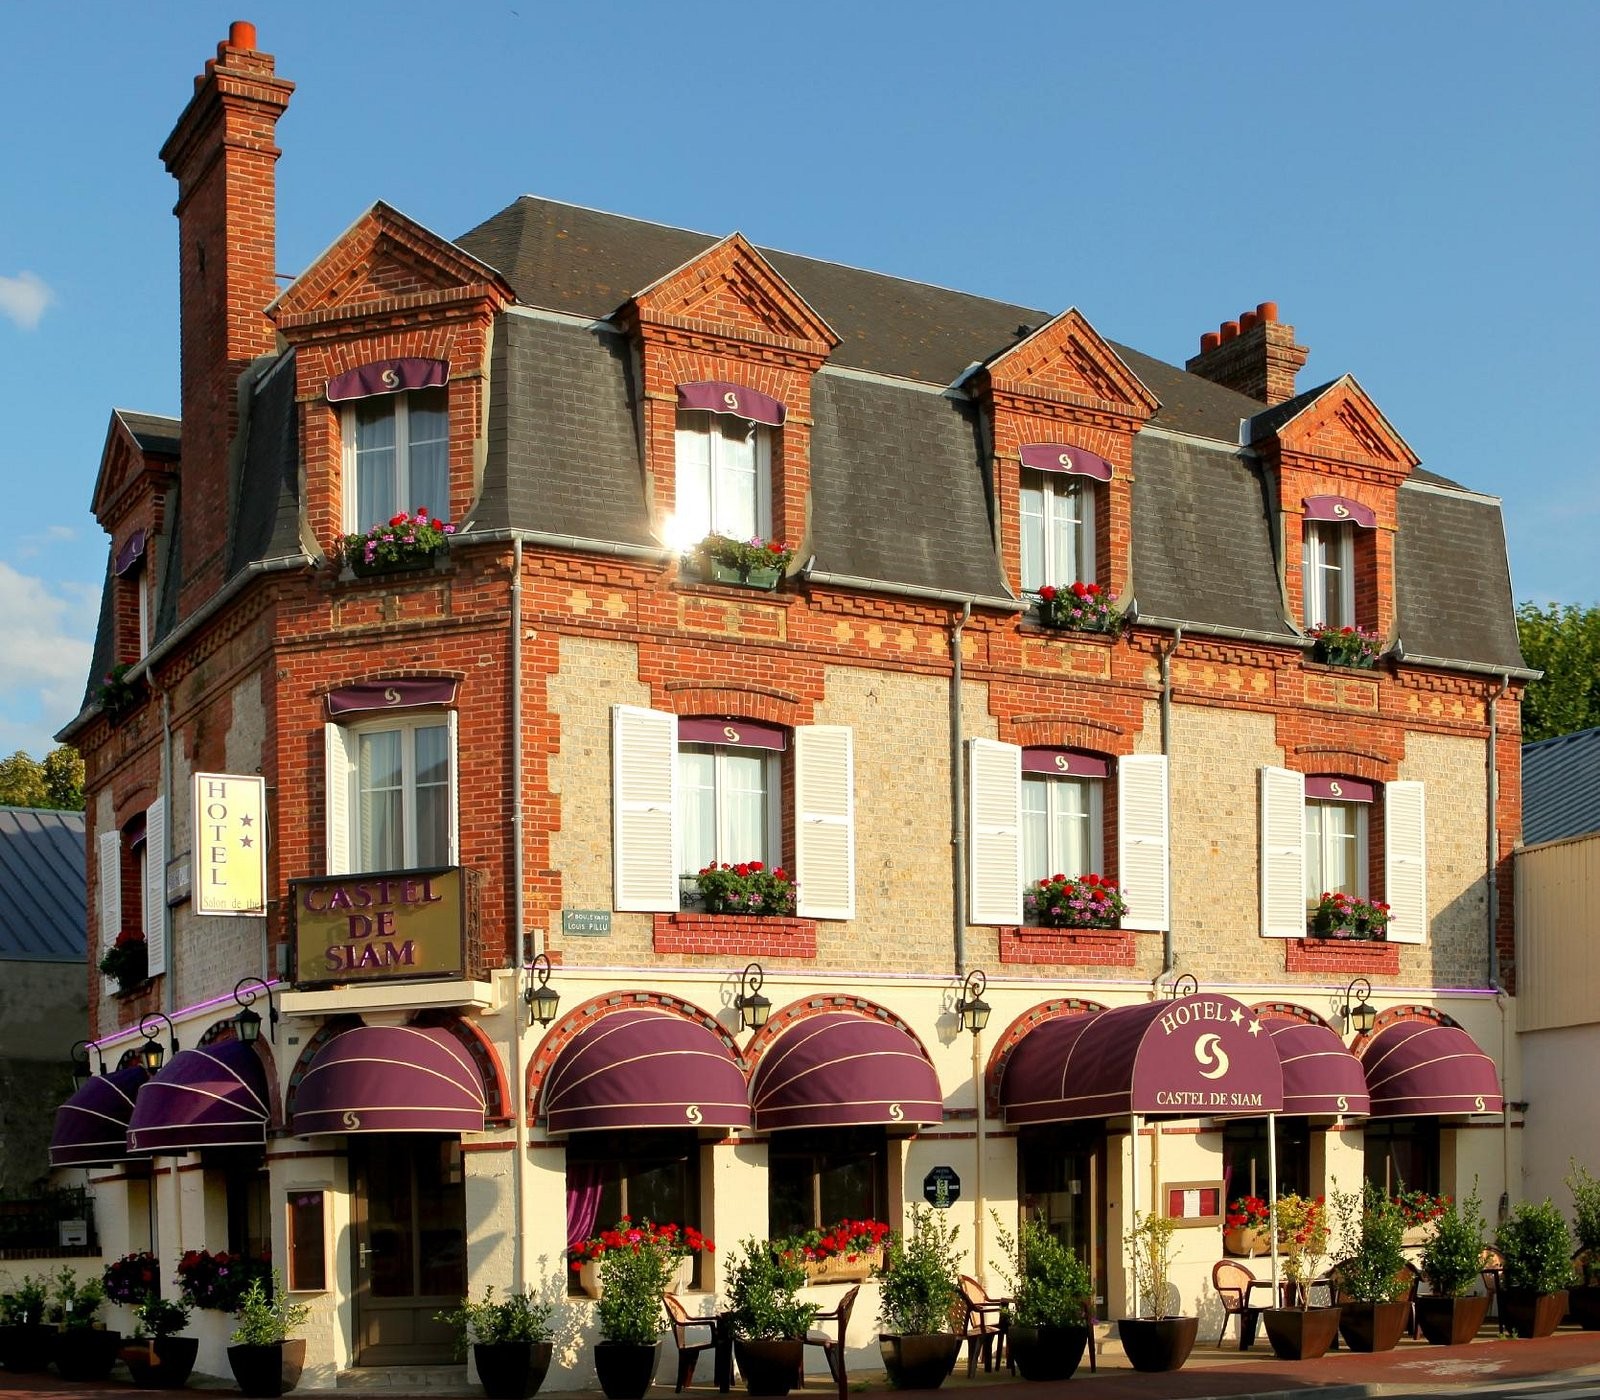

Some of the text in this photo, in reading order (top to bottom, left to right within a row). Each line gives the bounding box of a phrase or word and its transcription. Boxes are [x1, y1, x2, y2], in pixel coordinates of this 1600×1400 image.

[207, 781, 227, 885] HOTEL
[203, 896, 226, 909] Salon
[232, 898, 242, 909] de
[303, 877, 442, 912] CASTEL
[347, 911, 397, 939] DE
[568, 922, 585, 930] LOUIS
[574, 913, 609, 921] BOULEVARD
[325, 939, 416, 972] SIAM
[1160, 1001, 1228, 1035] HOTEL
[1156, 1091, 1262, 1106] CASTEL DE SIAM
